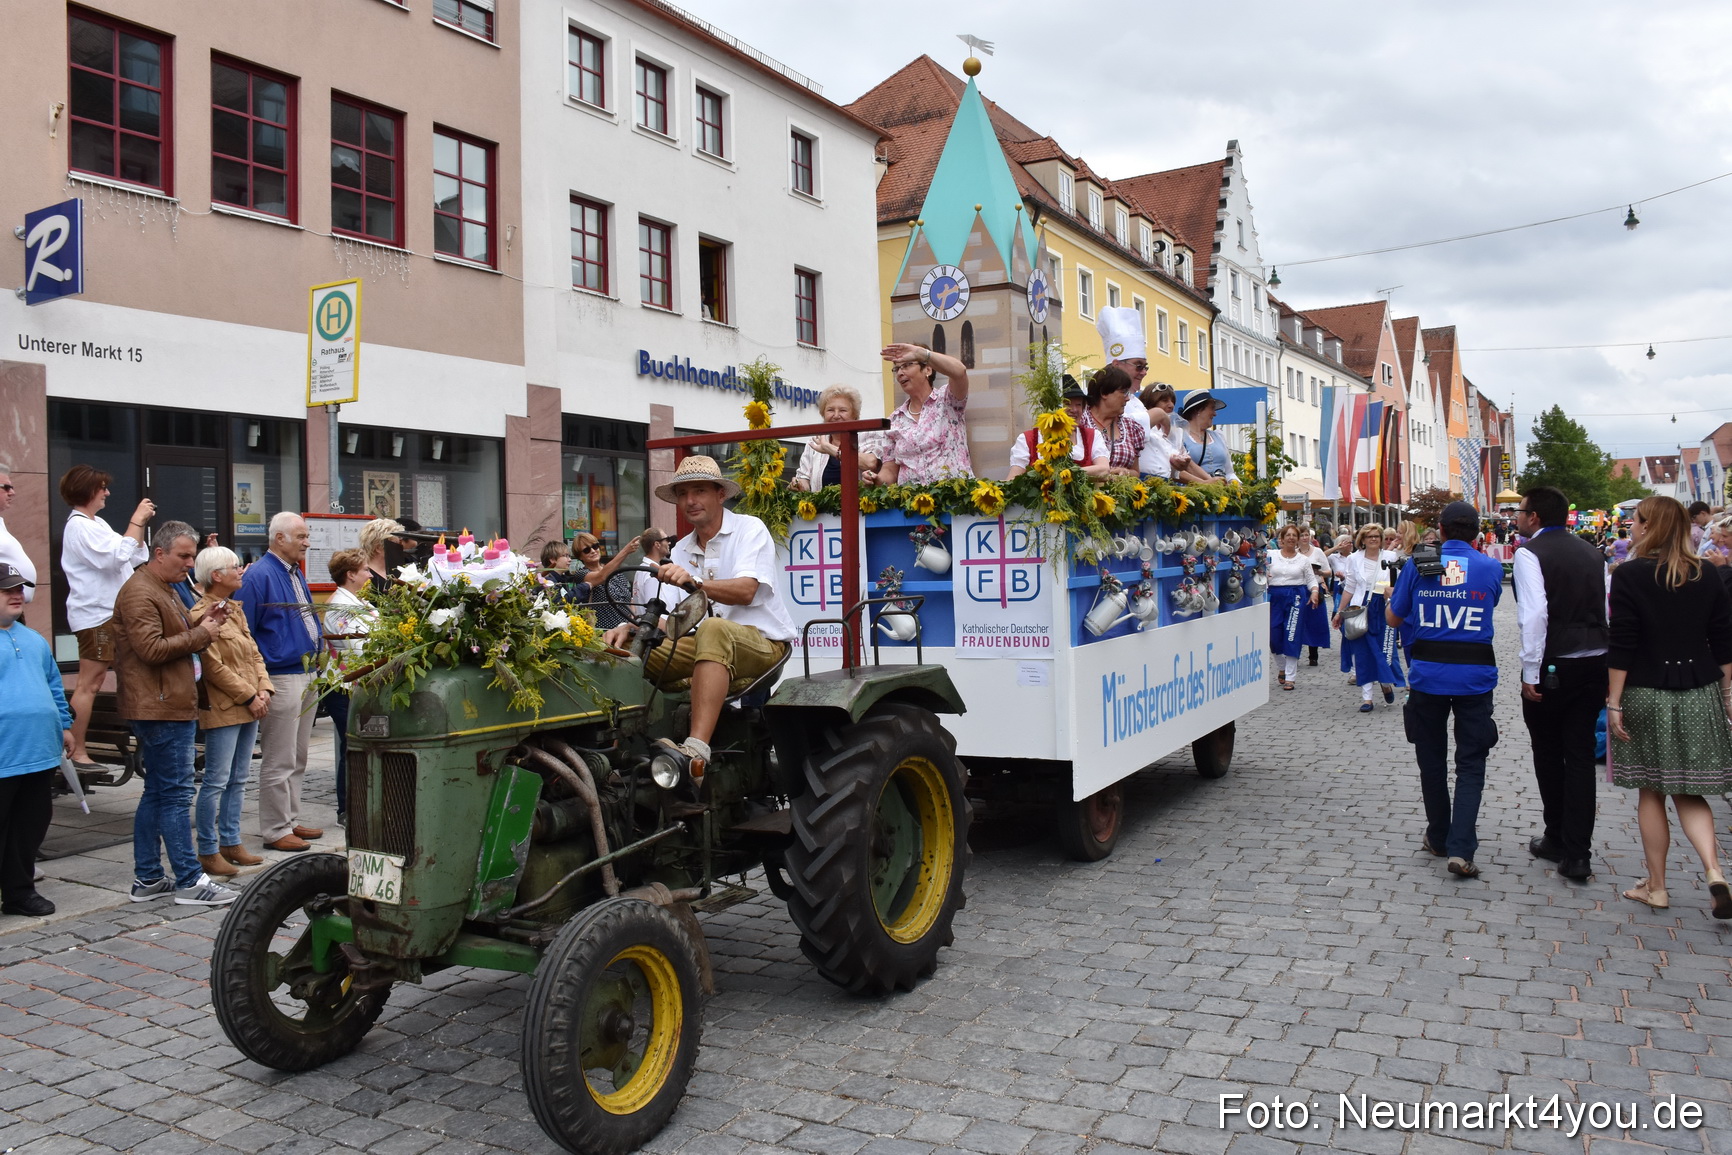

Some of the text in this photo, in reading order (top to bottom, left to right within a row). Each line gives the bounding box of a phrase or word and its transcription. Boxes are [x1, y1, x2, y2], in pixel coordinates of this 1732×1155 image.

[326, 300, 342, 331] H
[18, 333, 143, 363] Unterer Markt 15
[320, 346, 345, 356] Rathaus
[636, 349, 757, 396] Buchhandlu
[1501, 453, 1511, 488] HOTE
[1417, 588, 1486, 600] neumarkt TV
[962, 623, 1049, 634] Katholischer Deutscher
[1418, 603, 1484, 631] LIVE
[962, 636, 1050, 648] FRAUENBUND
[1102, 631, 1263, 748] Münstercafe des Frauenbundes
[362, 854, 385, 877] NM
[349, 873, 395, 900] DR 46
